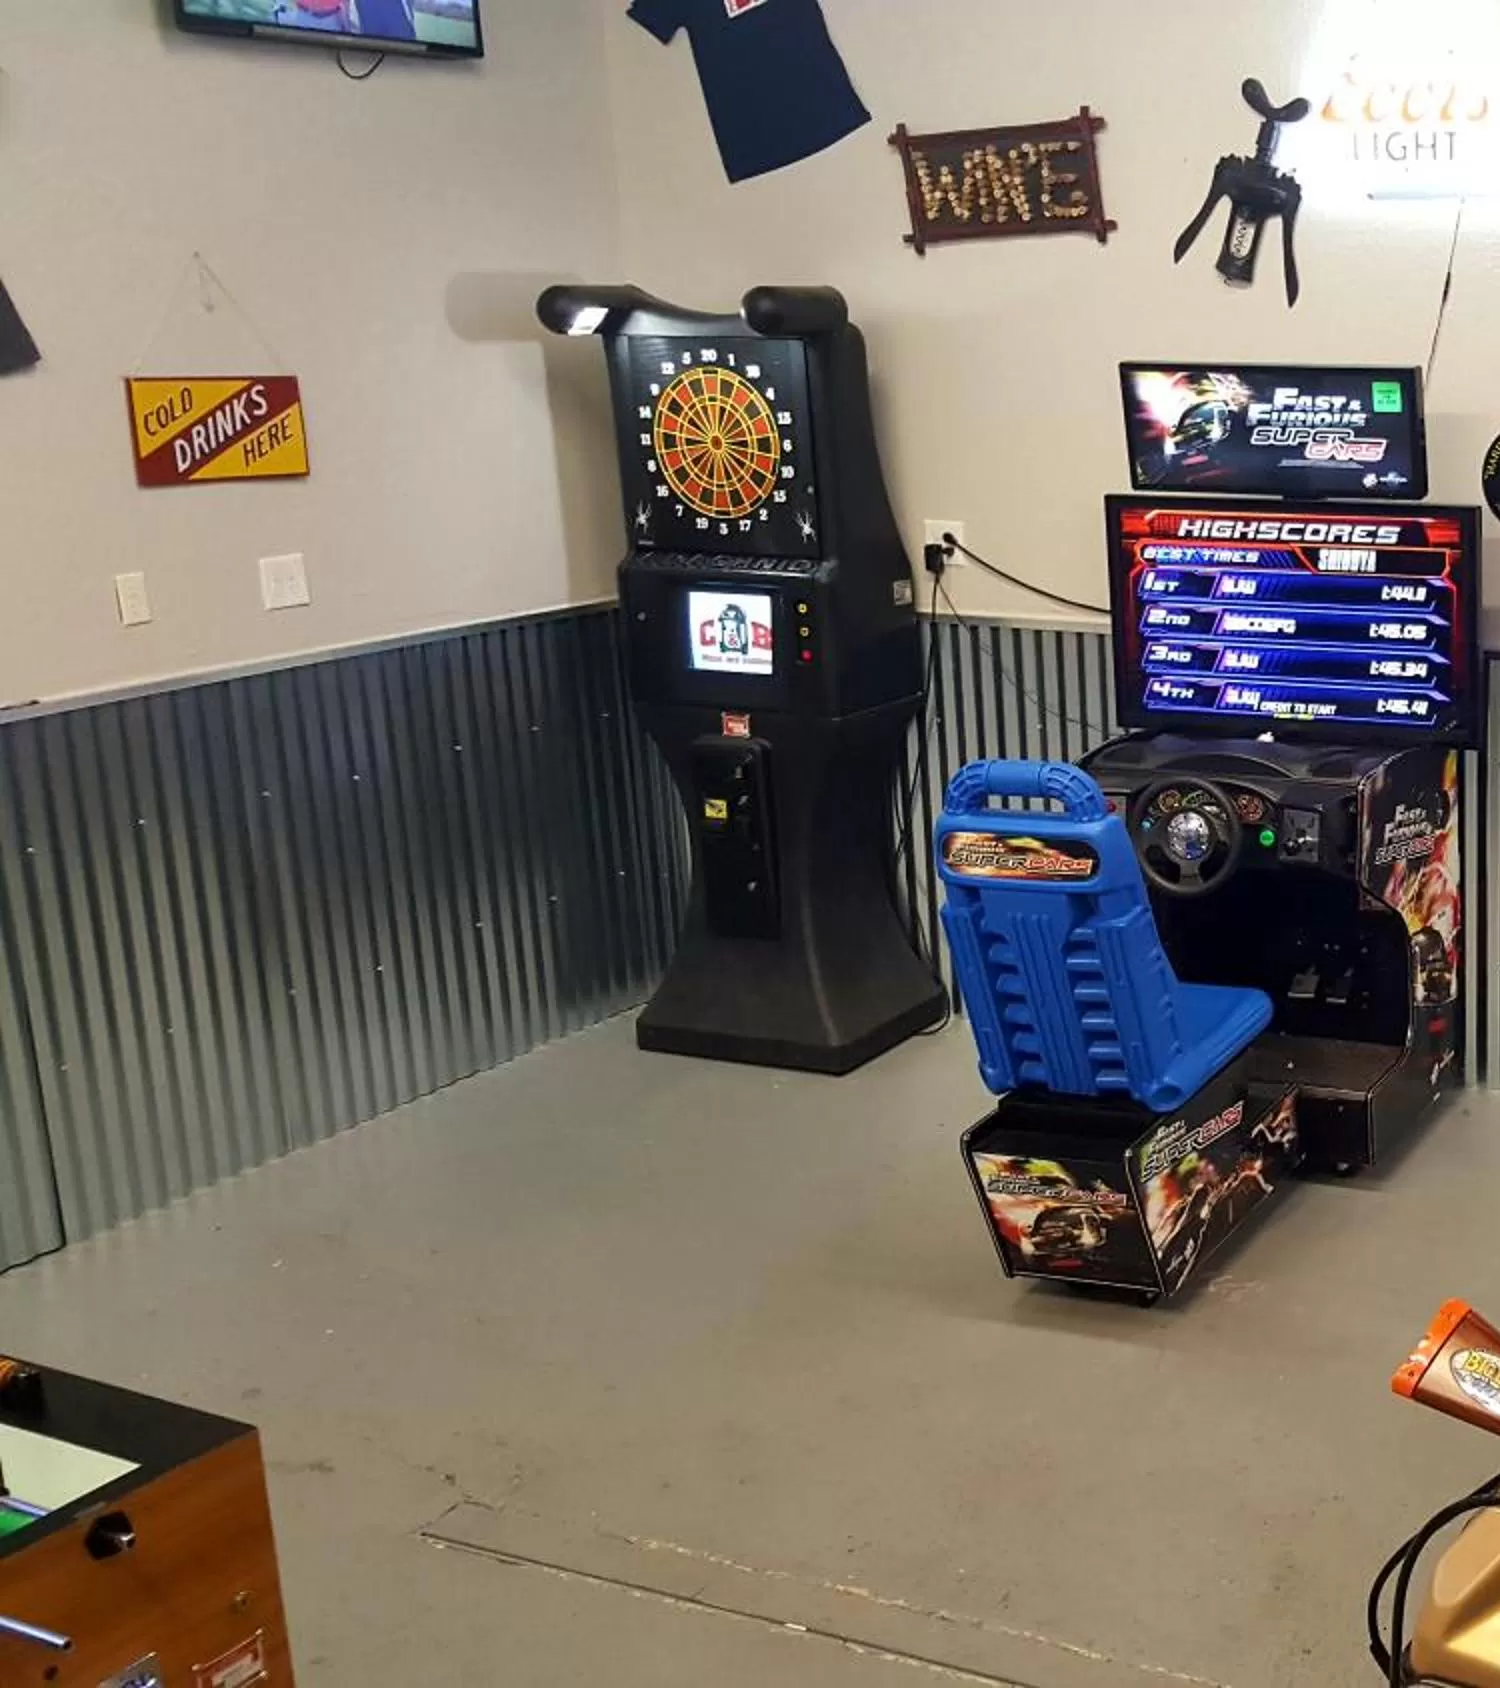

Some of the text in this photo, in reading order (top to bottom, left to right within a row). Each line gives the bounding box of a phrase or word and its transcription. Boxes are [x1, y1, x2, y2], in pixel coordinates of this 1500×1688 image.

[682, 352, 691, 365] 5
[701, 349, 717, 362] 20
[728, 354, 735, 366] 1
[765, 387, 775, 401] 4
[1273, 387, 1347, 411] FAST
[143, 387, 193, 437] COLD
[1246, 403, 1367, 427] FURIOUS
[174, 384, 267, 473] DRINKS
[1250, 426, 1355, 447] SUPER
[243, 413, 293, 467] HERE
[783, 440, 792, 452] 6
[1304, 438, 1387, 462] CARS
[781, 466, 795, 479] 10
[656, 485, 669, 498] 16
[675, 505, 684, 517] 7
[759, 507, 768, 521] 2
[739, 519, 751, 531] 17
[1178, 518, 1400, 545] HIGHSCORES
[1143, 547, 1260, 563] BEST TIMES
[1149, 646, 1192, 662] 3RD
[1152, 682, 1194, 699] 4TH
